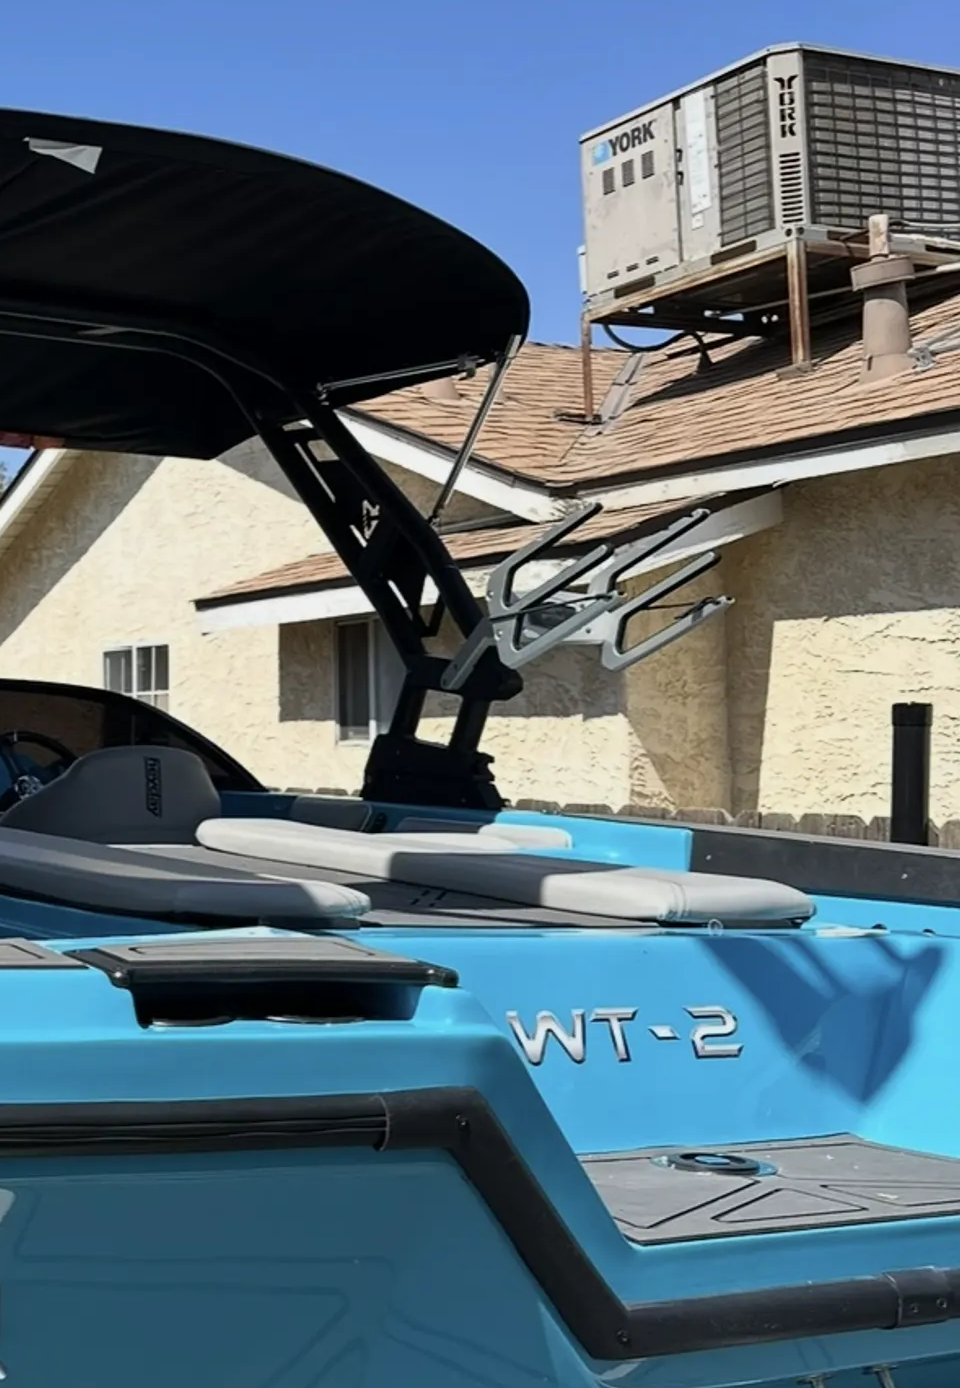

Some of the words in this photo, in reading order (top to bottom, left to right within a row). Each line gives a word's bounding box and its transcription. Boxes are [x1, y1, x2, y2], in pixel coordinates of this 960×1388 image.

[773, 74, 798, 138] YORK
[608, 120, 656, 156] YORK
[505, 1005, 744, 1066] WT-2
